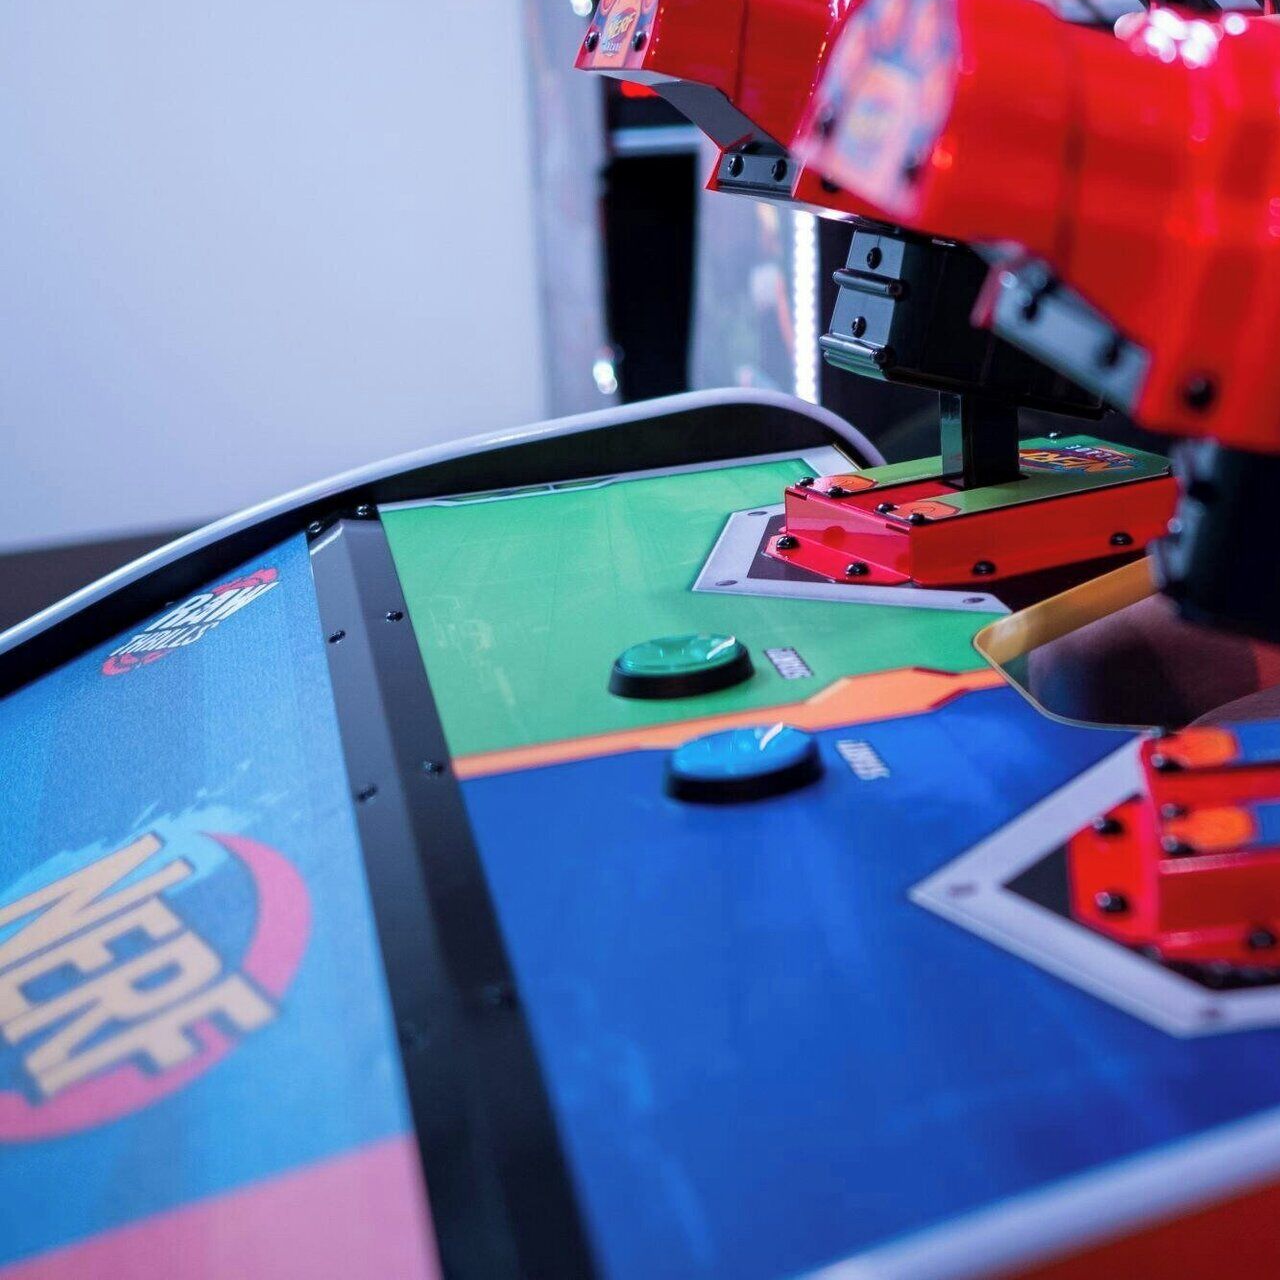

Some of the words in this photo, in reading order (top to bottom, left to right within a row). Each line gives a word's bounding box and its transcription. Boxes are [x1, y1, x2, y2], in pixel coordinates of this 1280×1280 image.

[144, 582, 279, 632] RAW
[109, 621, 219, 657] THRILLS
[0, 831, 277, 1097] NERF
